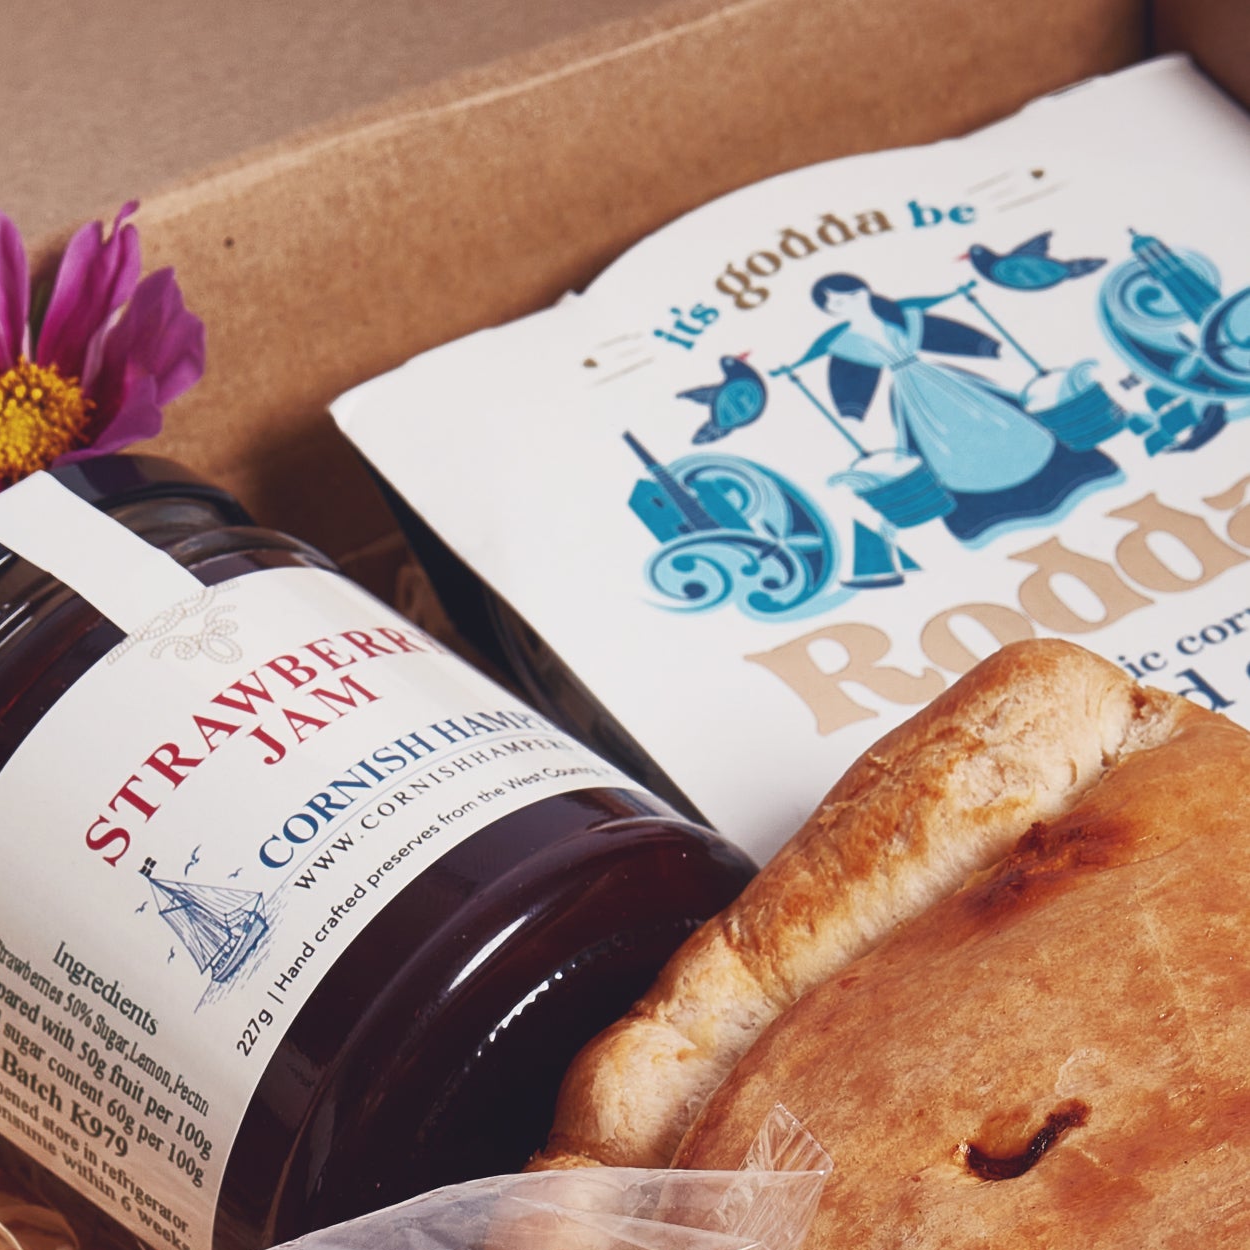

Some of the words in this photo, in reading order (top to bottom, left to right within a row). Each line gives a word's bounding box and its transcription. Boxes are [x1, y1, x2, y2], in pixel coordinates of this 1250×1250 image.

[907, 199, 976, 228] be
[246, 674, 385, 766] JAM
[258, 731, 437, 871] CORNISH
[236, 1007, 274, 1057] 227g
[274, 941, 316, 993] Hand
[315, 884, 368, 943] crafted
[366, 822, 440, 889] preserves
[438, 799, 479, 825] from
[477, 786, 506, 804] the
[502, 772, 546, 790] West
[52, 941, 159, 1036] Ingredients
[63, 992, 93, 1028] 50%
[0, 1047, 62, 1114] Batch
[69, 1099, 129, 1158] K979
[3, 1022, 46, 1062] sugar
[47, 1056, 104, 1107] content
[106, 1098, 135, 1136] 60g
[137, 1123, 165, 1152] per
[167, 1142, 205, 1189] 100g
[42, 1014, 76, 1052] with
[77, 1041, 107, 1081] 50g
[108, 1064, 144, 1105] fruit
[144, 1095, 174, 1125] per
[175, 1115, 213, 1161] 100g
[41, 1114, 79, 1152] store
[83, 1141, 98, 1168] in
[62, 1151, 117, 1203] within
[120, 1195, 132, 1212] 6
